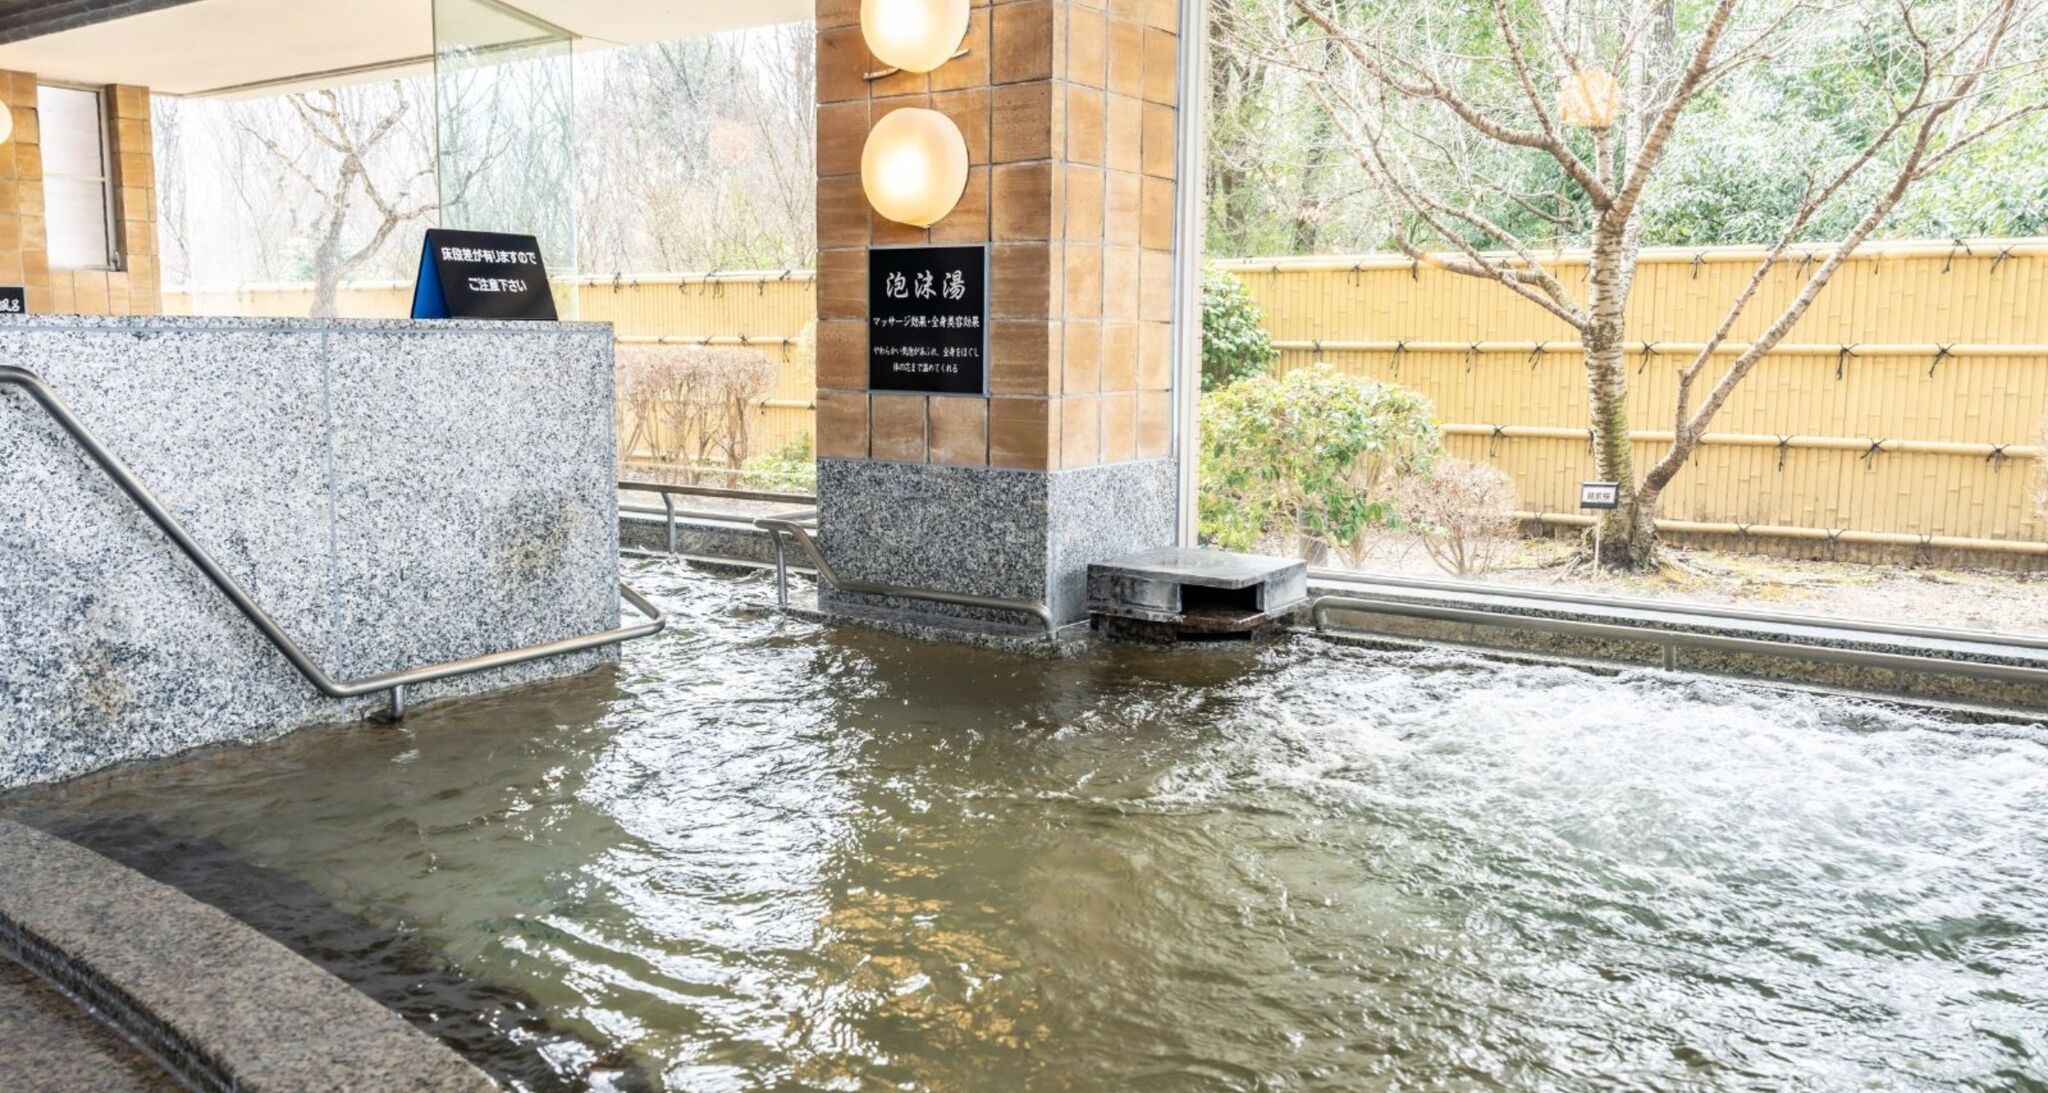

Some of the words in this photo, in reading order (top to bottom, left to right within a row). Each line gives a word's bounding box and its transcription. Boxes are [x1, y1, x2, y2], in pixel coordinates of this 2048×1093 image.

[441, 246, 537, 265] 床段差が有りますので
[468, 277, 528, 292] ご注意下さい
[886, 270, 966, 300] 泡沫湯
